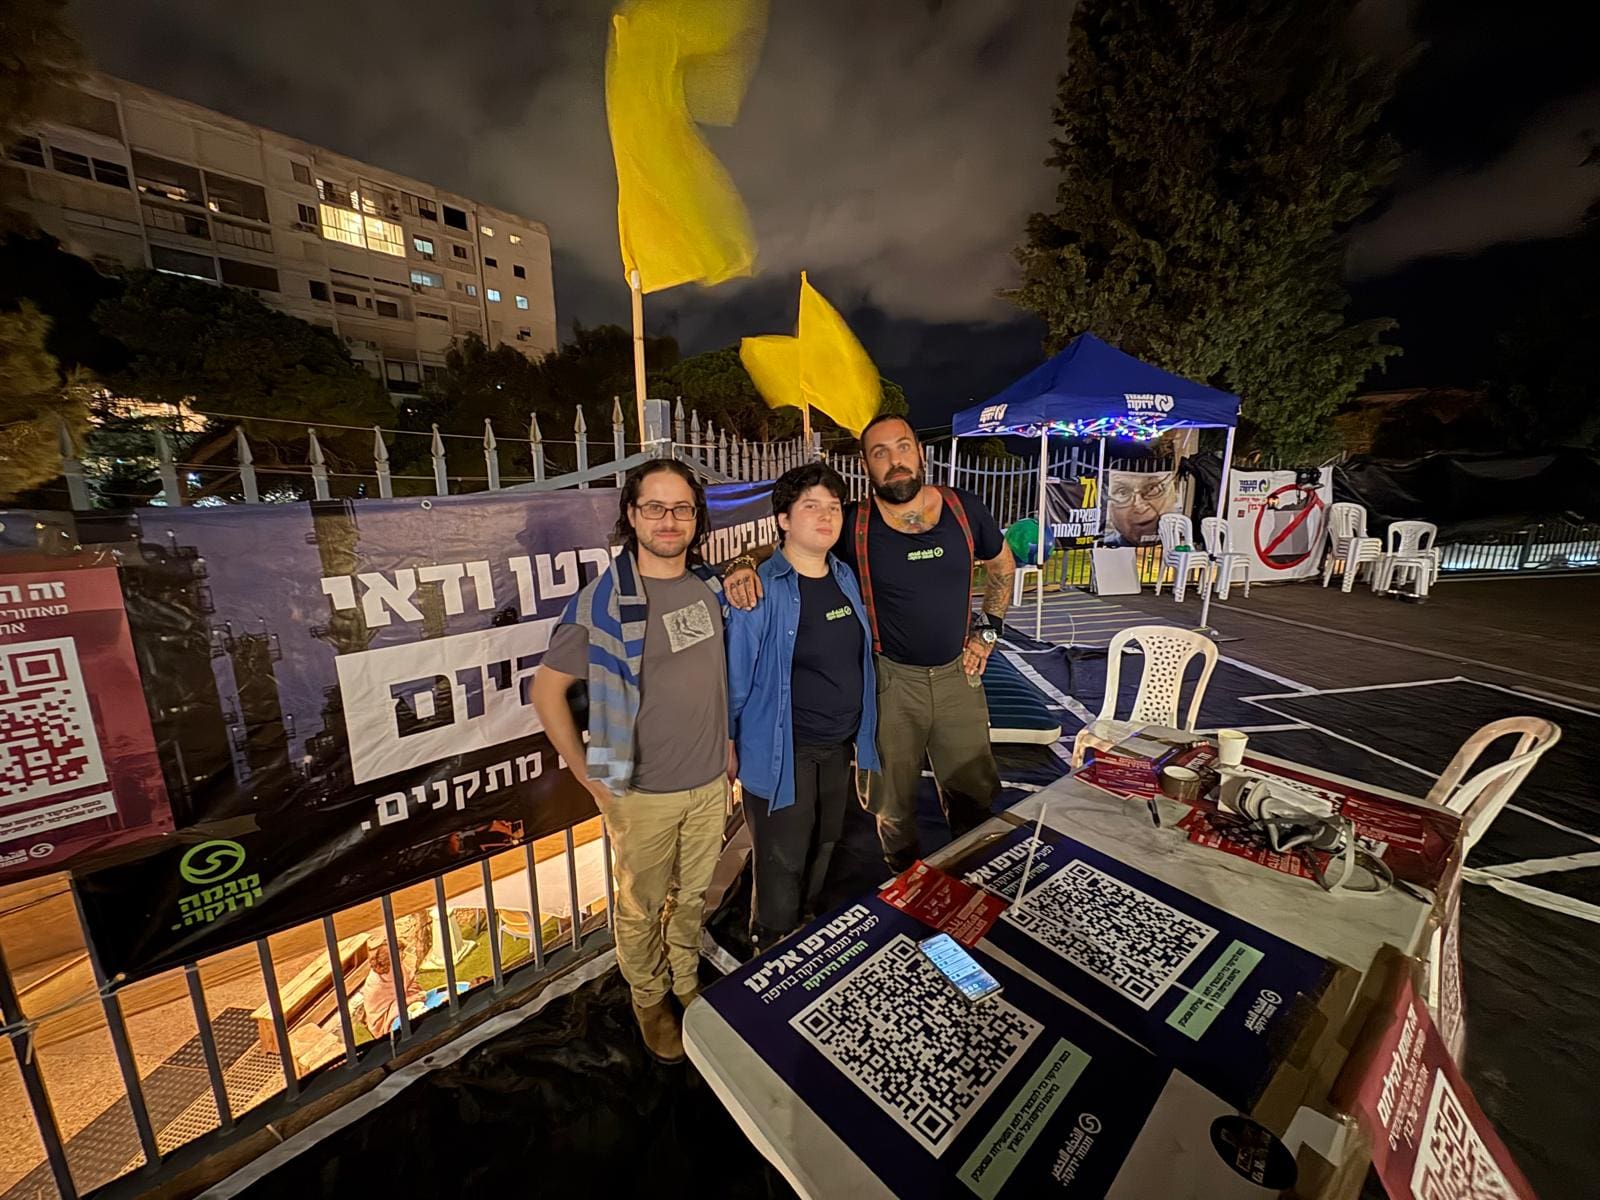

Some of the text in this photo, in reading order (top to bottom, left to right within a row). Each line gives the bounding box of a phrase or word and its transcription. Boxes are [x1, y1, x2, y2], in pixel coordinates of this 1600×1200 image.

[1051, 523, 1081, 537] מאחור
[27, 581, 66, 601] זה
[320, 560, 496, 628] ודאי
[508, 545, 624, 616] רטן
[360, 751, 543, 831] מתקנים.
[171, 887, 263, 931] ירוקה.
[178, 873, 260, 913] מגמה
[743, 903, 871, 993] הצטרפו אלינו
[761, 914, 880, 1004] לפעילי מגמה ירוקה בחיפה
[802, 960, 841, 991] הירוקה
[1376, 1050, 1404, 1129] להילחם
